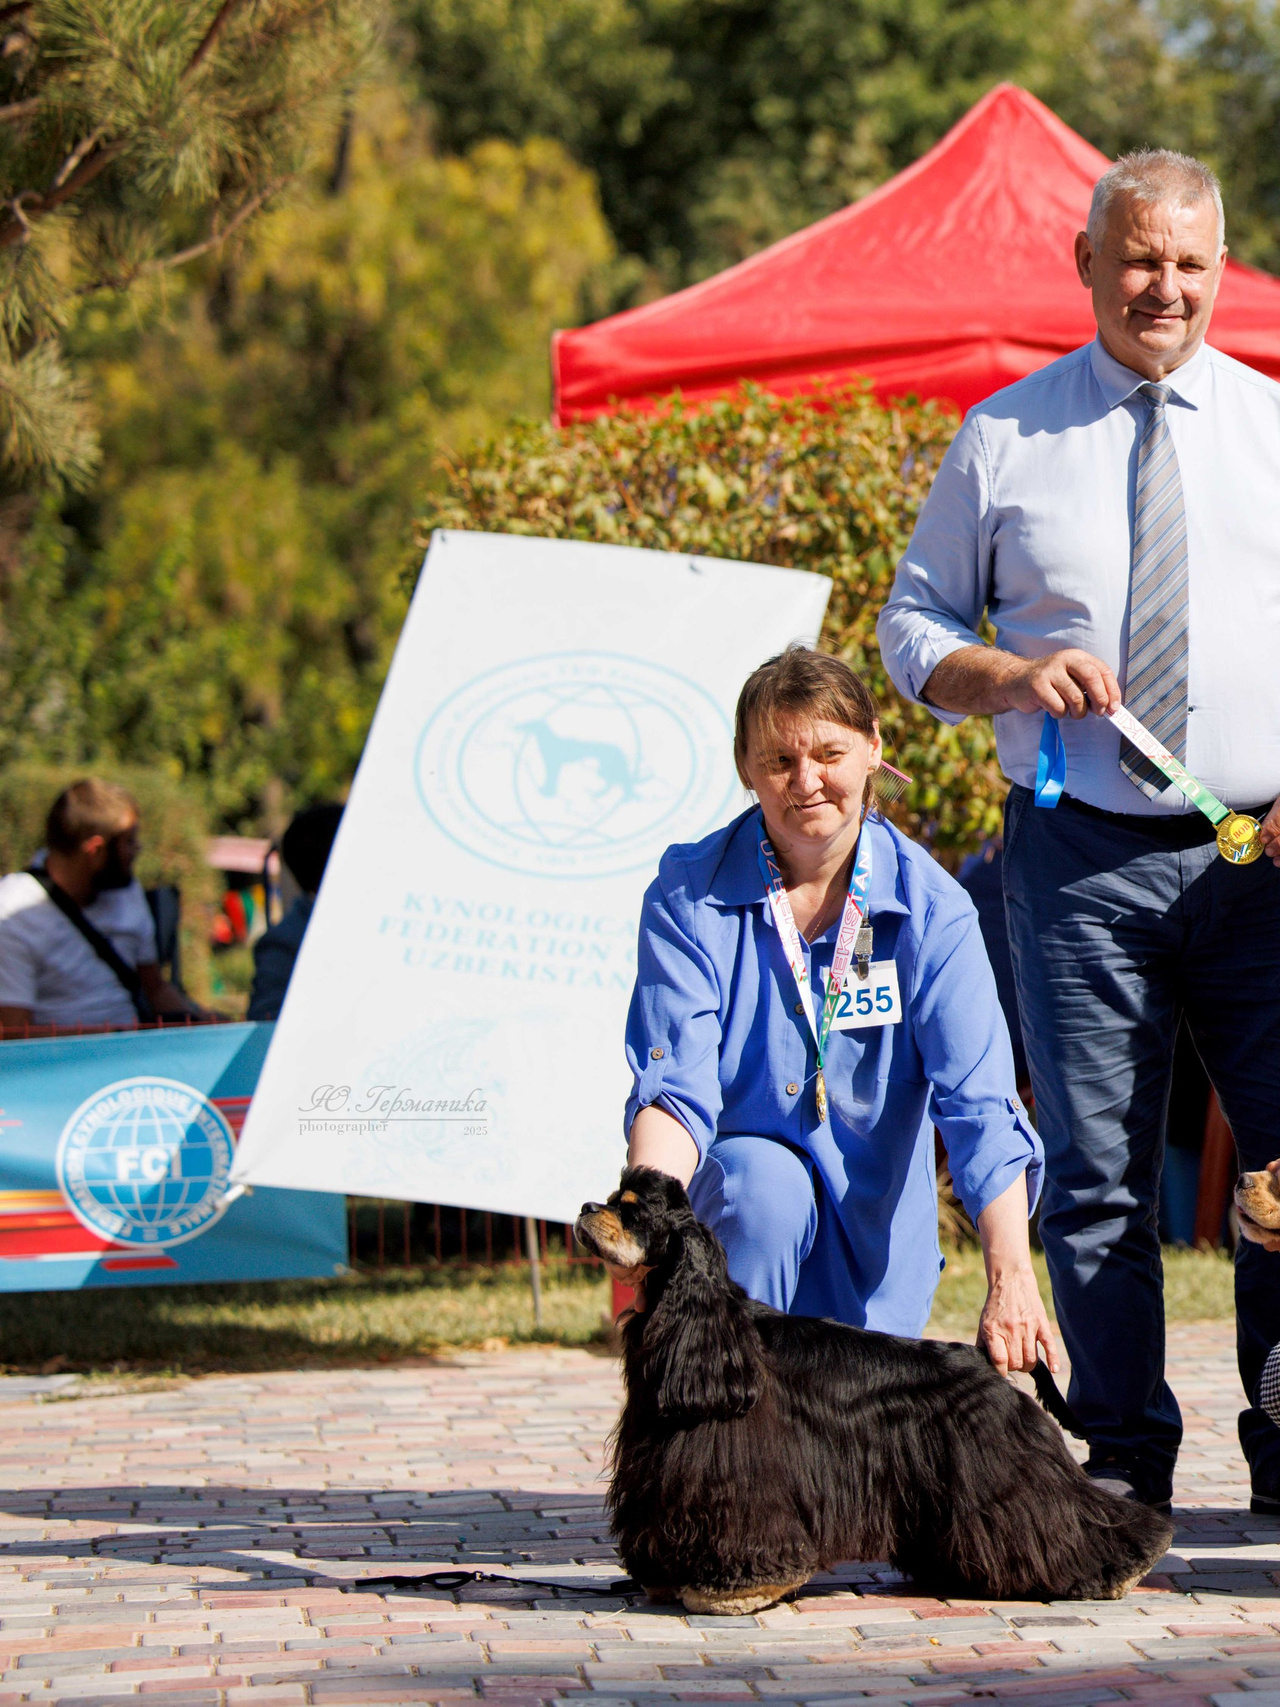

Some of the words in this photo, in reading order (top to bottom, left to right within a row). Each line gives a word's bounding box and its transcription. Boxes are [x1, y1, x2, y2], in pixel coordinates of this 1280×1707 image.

[1233, 822, 1251, 840] BOB
[403, 892, 636, 938] KYNOLOGICA
[378, 915, 612, 962] FEDERATION
[821, 850, 872, 1036] UZBEKISTAN
[403, 947, 633, 991] UZBEKISTAN
[836, 986, 893, 1019] 255
[72, 1087, 192, 1146] CYNOLOGIQUE
[117, 1144, 182, 1182] FCI
